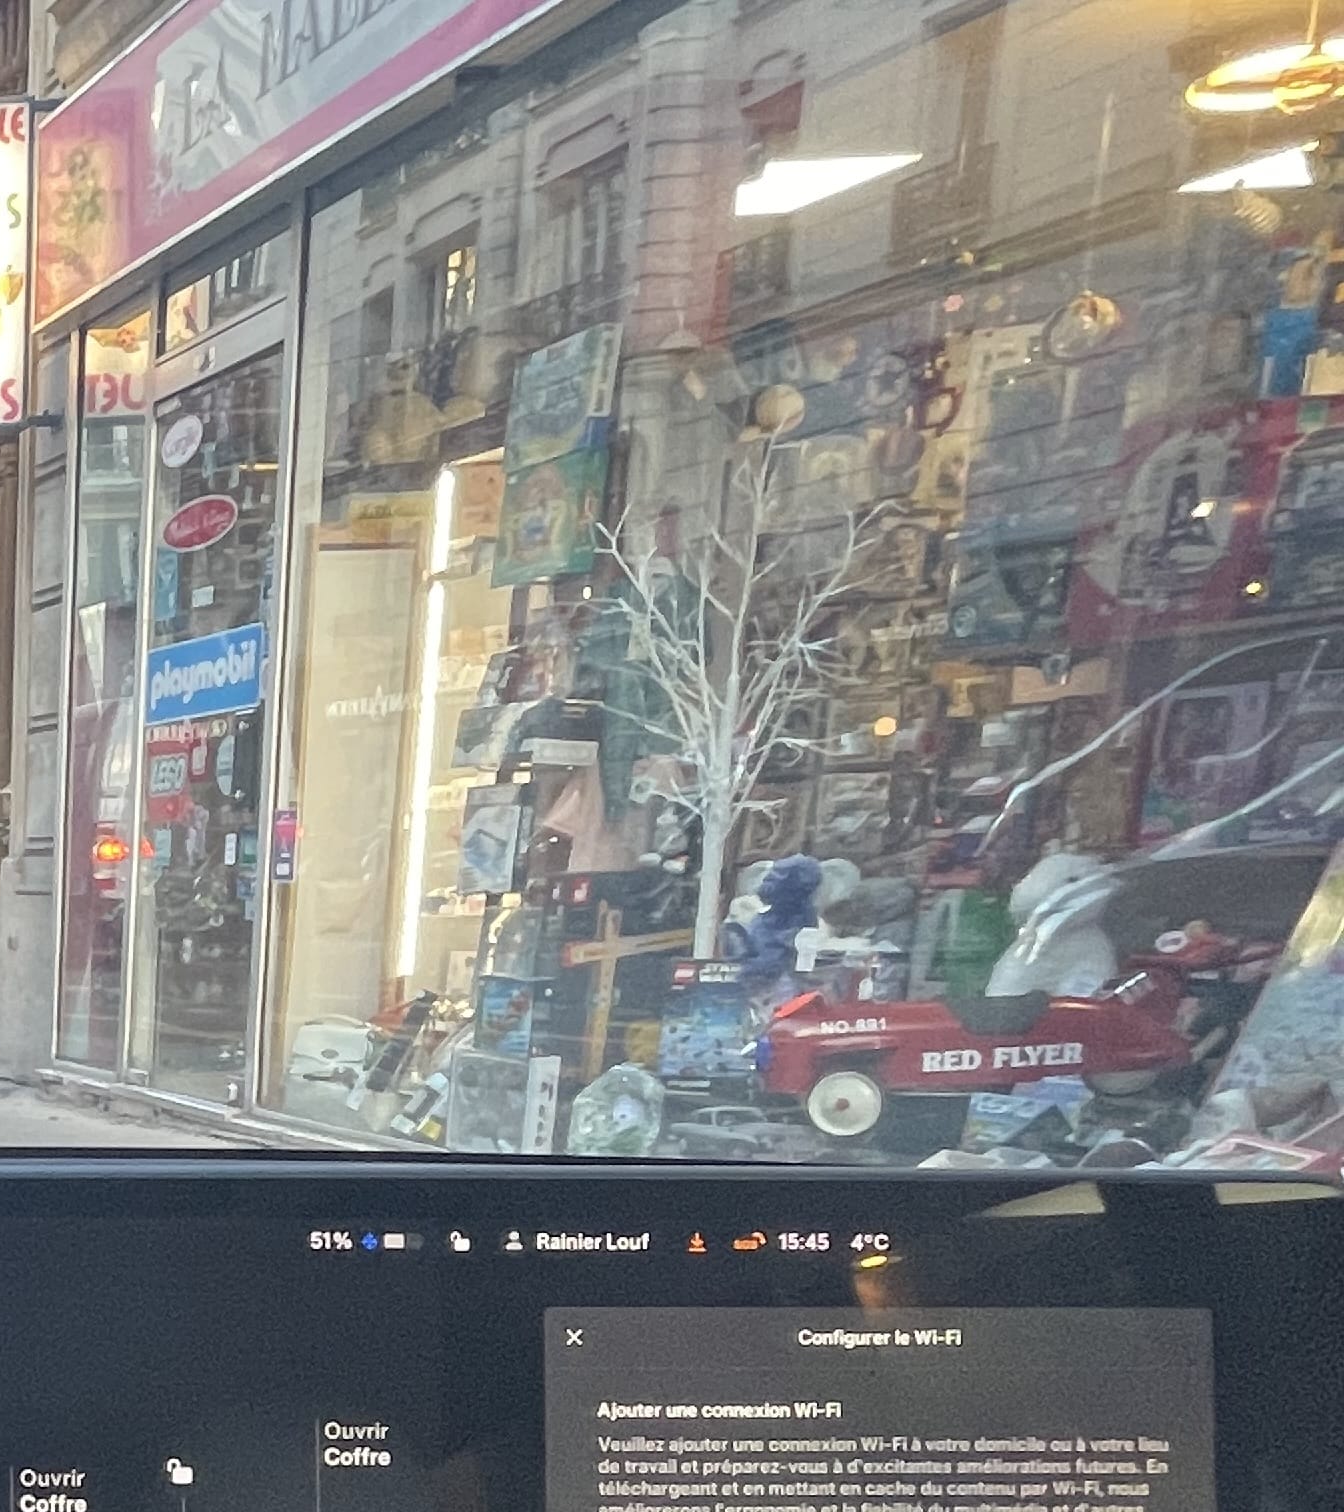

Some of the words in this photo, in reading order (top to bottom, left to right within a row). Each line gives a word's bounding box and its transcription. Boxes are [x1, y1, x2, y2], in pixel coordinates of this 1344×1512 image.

[151, 639, 257, 711] playmobil
[922, 1049, 983, 1073] RED
[992, 1042, 1084, 1070] FLYER
[310, 1231, 353, 1251] 51%
[536, 1232, 600, 1251] Rainier
[606, 1232, 650, 1251] Louf
[778, 1232, 830, 1251] 15:45
[851, 1232, 890, 1252] 4°C
[798, 1329, 891, 1349] Configurer
[895, 1329, 911, 1346] le
[914, 1329, 962, 1346] Wi-Fi
[597, 1402, 662, 1421] Ajouter
[666, 1404, 698, 1418] une
[701, 1402, 791, 1418] connexion
[794, 1402, 842, 1418] Wi-Fi
[324, 1422, 389, 1441] Ouvrir
[598, 1437, 665, 1452] Veuillez
[668, 1437, 728, 1455] ajouter
[732, 1440, 764, 1452] une
[769, 1437, 857, 1452] connexion
[861, 1437, 907, 1452] Wi-Fi
[911, 1436, 921, 1451] à
[925, 1438, 971, 1451] votre
[974, 1437, 1046, 1451] domicile
[1050, 1439, 1072, 1451] ou
[1076, 1436, 1086, 1451] à
[1090, 1438, 1135, 1451] votre
[1138, 1436, 1169, 1451] lieu
[324, 1447, 392, 1467] Coffre
[20, 1469, 86, 1488] Ouvrir
